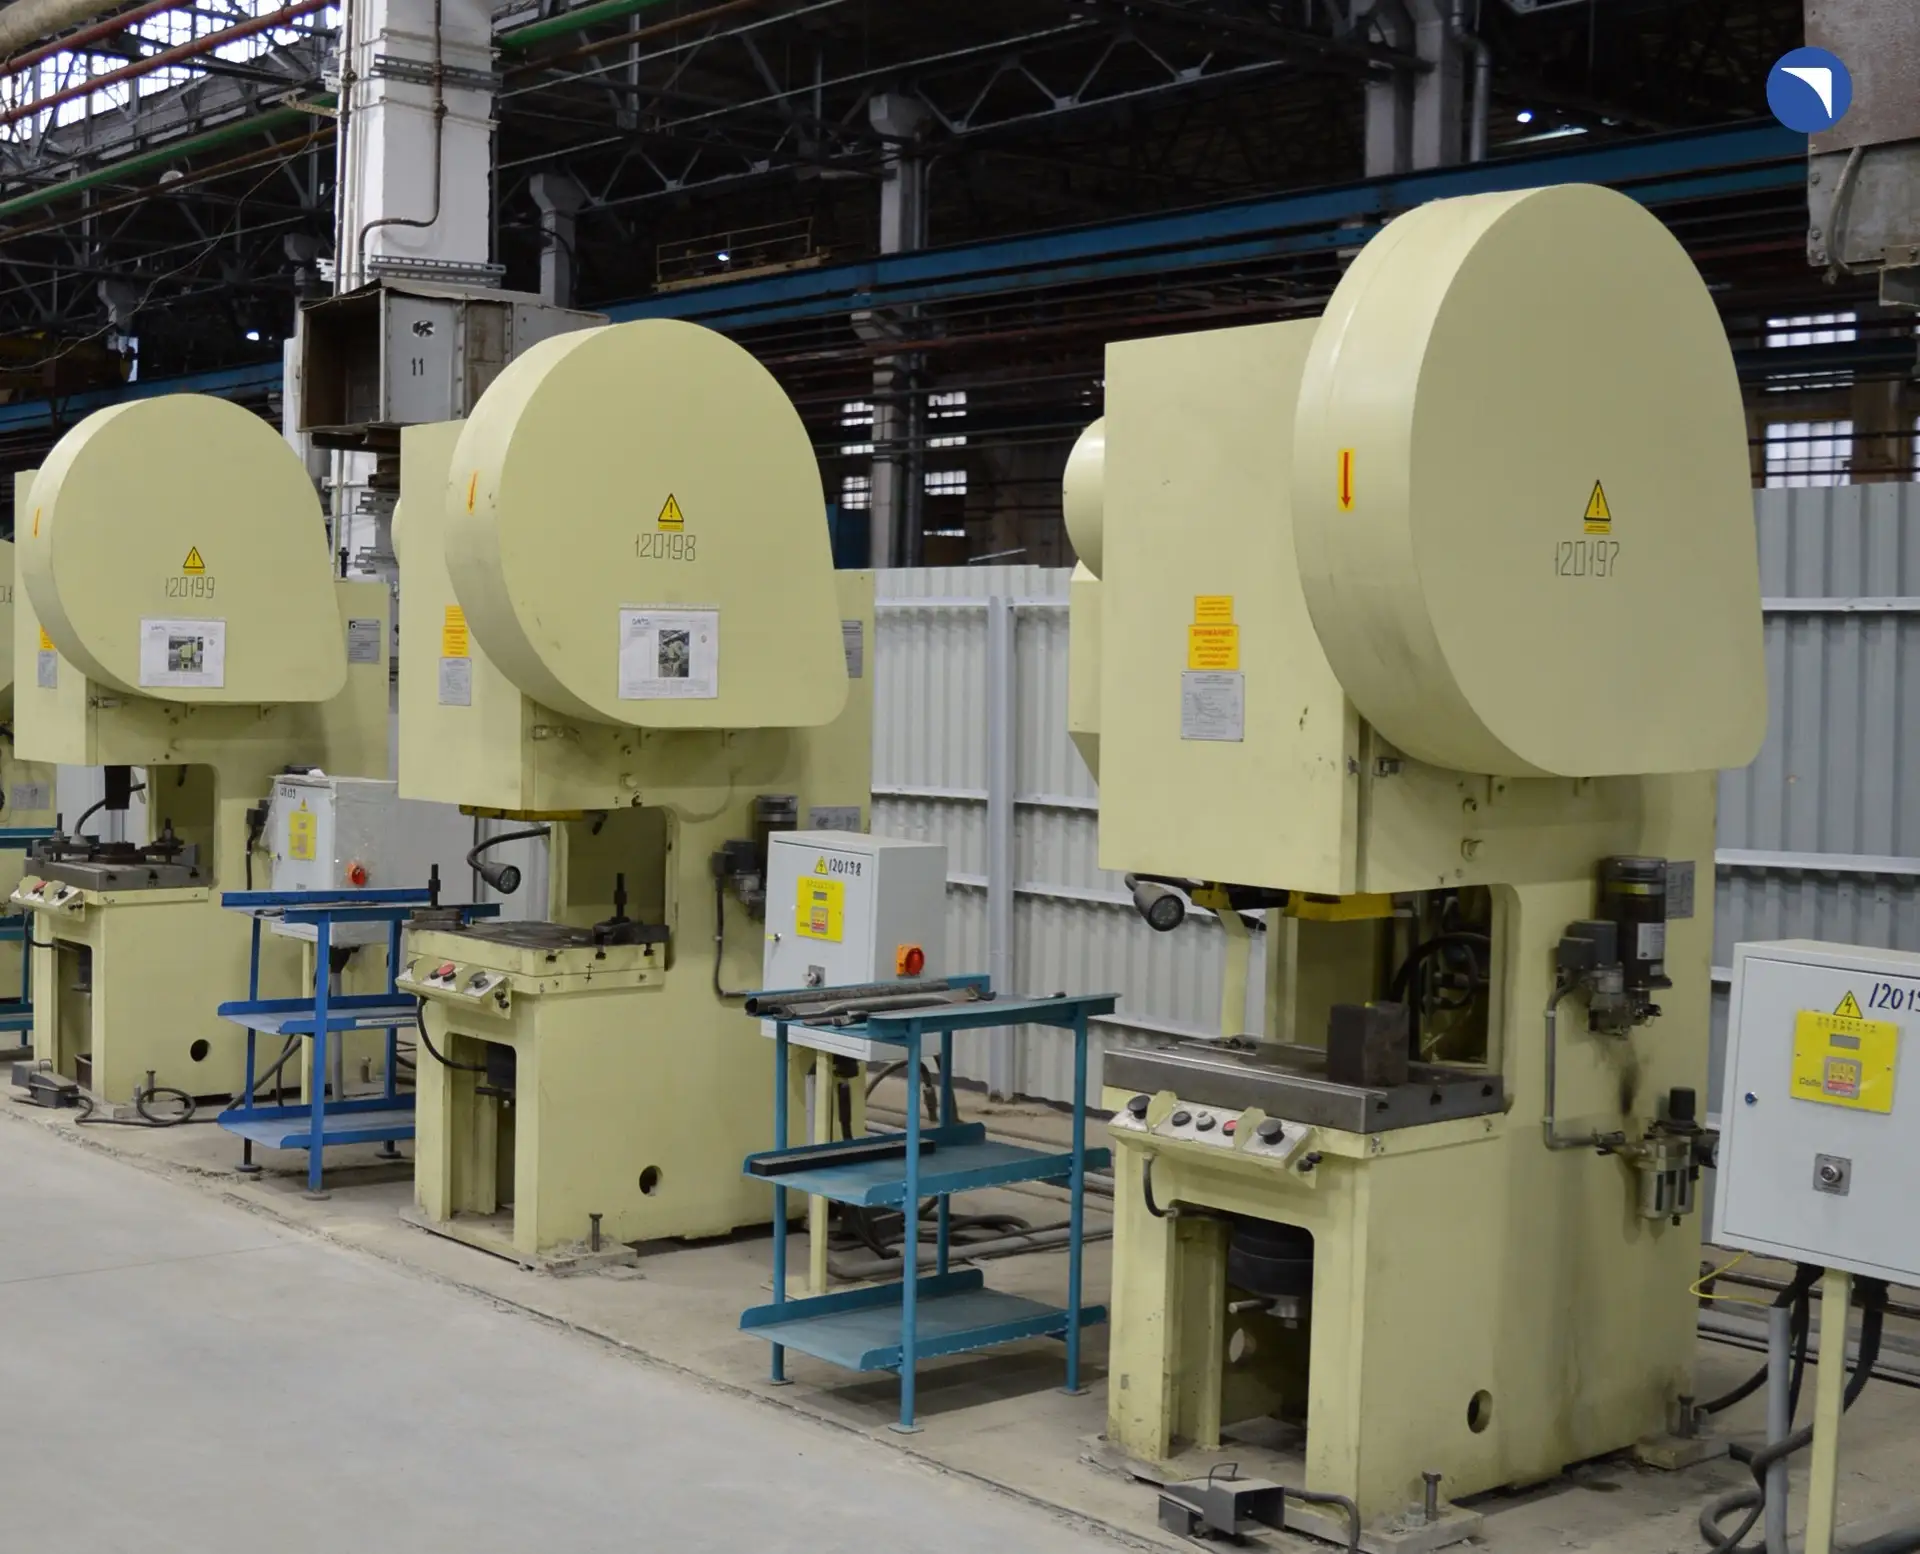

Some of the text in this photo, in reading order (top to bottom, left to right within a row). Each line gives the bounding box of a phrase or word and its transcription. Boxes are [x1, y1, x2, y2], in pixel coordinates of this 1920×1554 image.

[412, 357, 424, 376] 11
[635, 533, 696, 561] 120198
[1555, 540, 1620, 577] 120197
[165, 576, 215, 599] 120199
[828, 857, 861, 877] 120198
